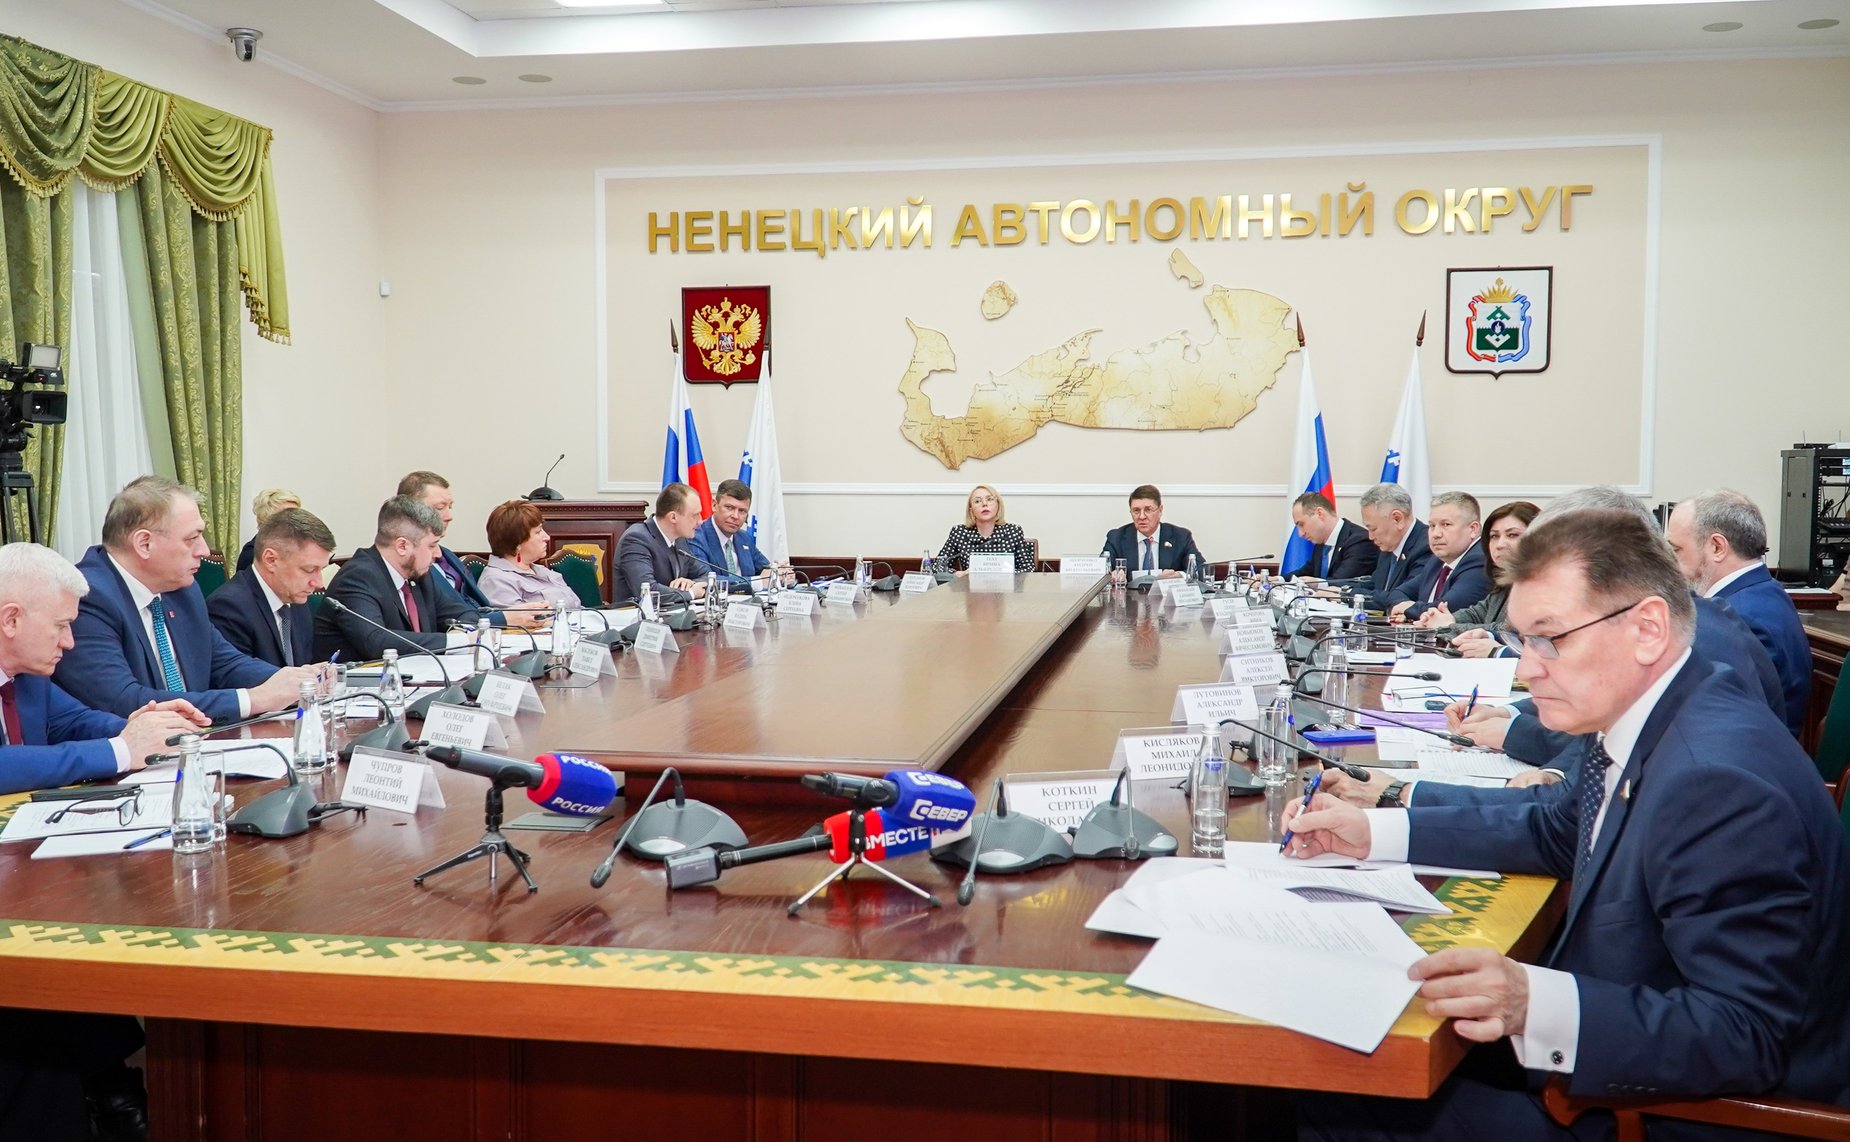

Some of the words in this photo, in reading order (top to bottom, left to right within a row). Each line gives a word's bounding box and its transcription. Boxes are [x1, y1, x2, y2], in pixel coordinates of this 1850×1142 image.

[648, 195, 933, 257] НЕНЕЦКИЙ
[950, 181, 1375, 247] АВТОНОМНЫЙ
[1396, 184, 1594, 235] ОКРУГ
[1240, 657, 1274, 665] СИТНИКОВ
[1193, 688, 1242, 699] ЛУТОВИНОВ
[1197, 698, 1244, 709] АЛЕКСАНДР
[442, 710, 475, 723] ХОЛОДОВ
[1208, 709, 1237, 718] ИЛЬИЧ
[446, 723, 464, 733] ОЛЕГ
[430, 732, 473, 747] ЕВГЕНЬЕВИЧ
[1143, 736, 1201, 748] КИСЛЯКОВ
[1151, 749, 1198, 759] МИХАИЛ
[371, 759, 403, 774] ЧУПРОВ
[1140, 761, 1193, 773] ЛЕОНИДО
[363, 773, 403, 789] ЛЕОНТИЙ
[351, 785, 409, 805] МИХАЙЛОВИЧ
[1041, 785, 1097, 797] КОТКИН
[551, 796, 606, 814] РОССИЯ
[1048, 797, 1095, 811] СЕРГЕЙ
[909, 798, 969, 823] СЕВЕР
